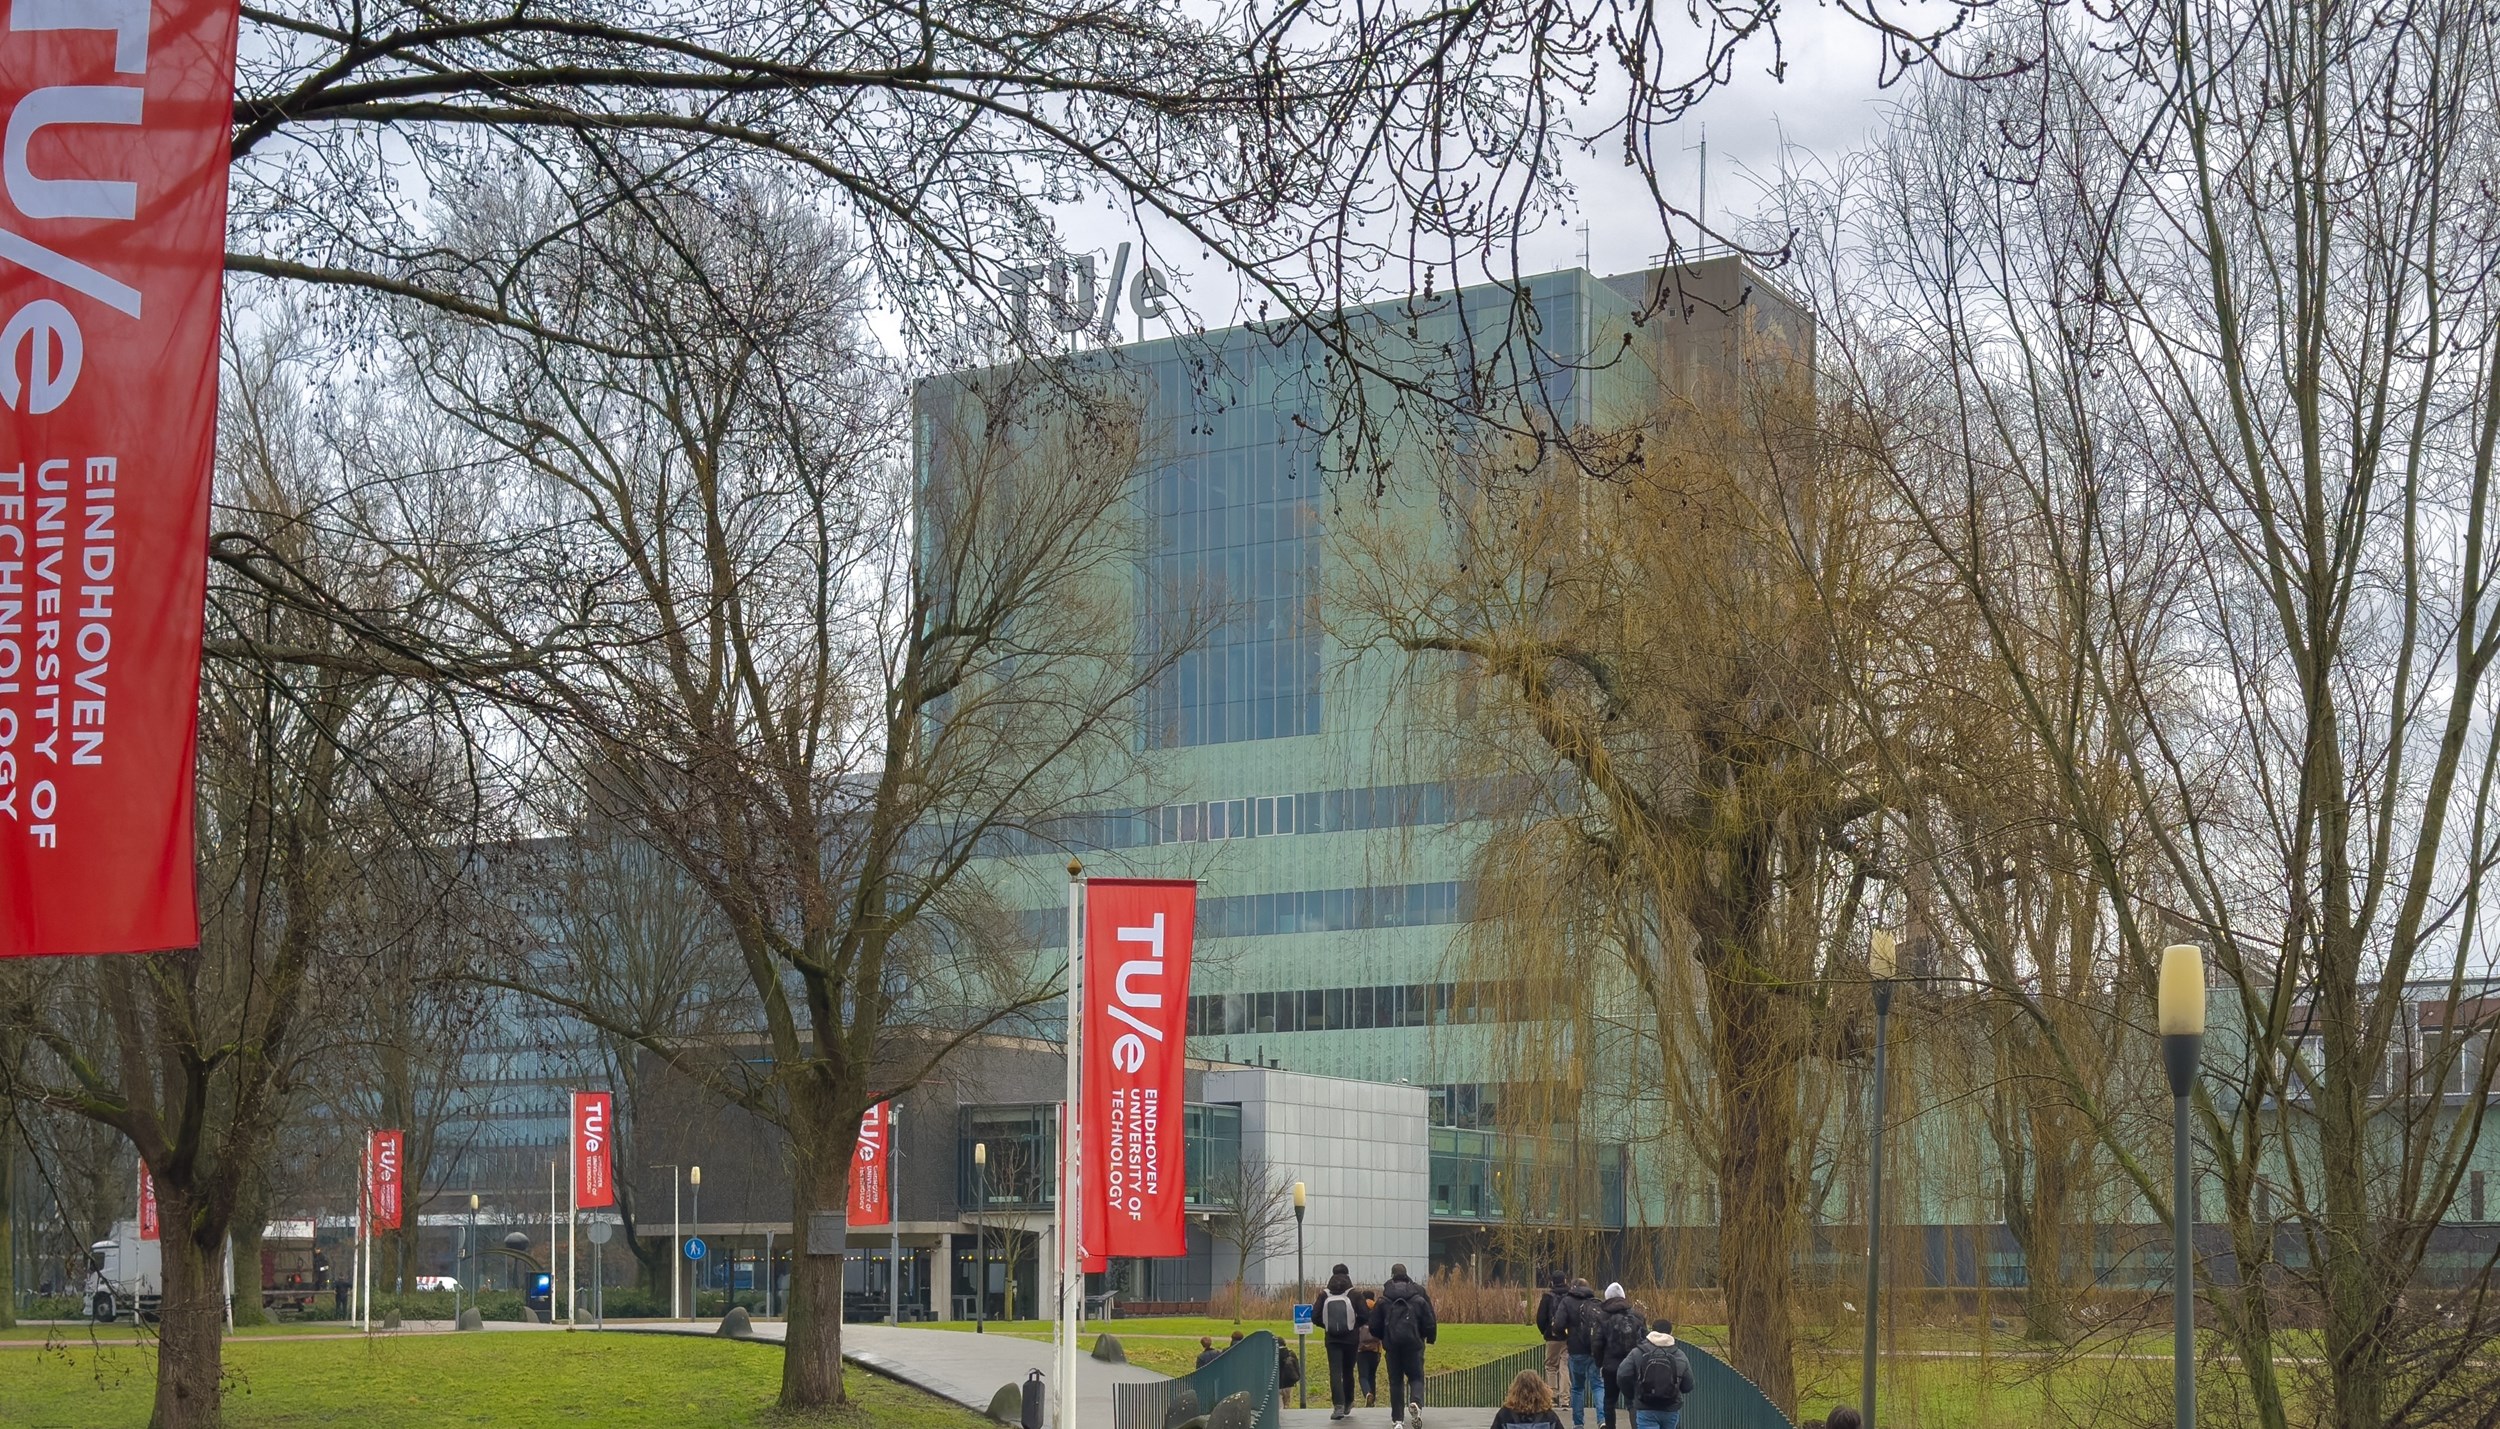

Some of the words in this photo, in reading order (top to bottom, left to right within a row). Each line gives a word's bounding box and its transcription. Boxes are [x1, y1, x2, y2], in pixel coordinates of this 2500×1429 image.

[998, 242, 1167, 340] TU/e
[34, 458, 70, 764] UNIVERSITY
[71, 456, 118, 766] EINDHOVEN
[30, 779, 57, 849] OF
[1107, 912, 1165, 1074] TU/e
[379, 1138, 396, 1182] TU/e
[583, 1101, 604, 1153] TU/e
[1109, 1087, 1125, 1210] TECHNOLOGY
[1128, 1088, 1142, 1193] UNIVERSITY
[1144, 1088, 1158, 1195] EINDHOVEN
[1128, 1196, 1142, 1221] OF
